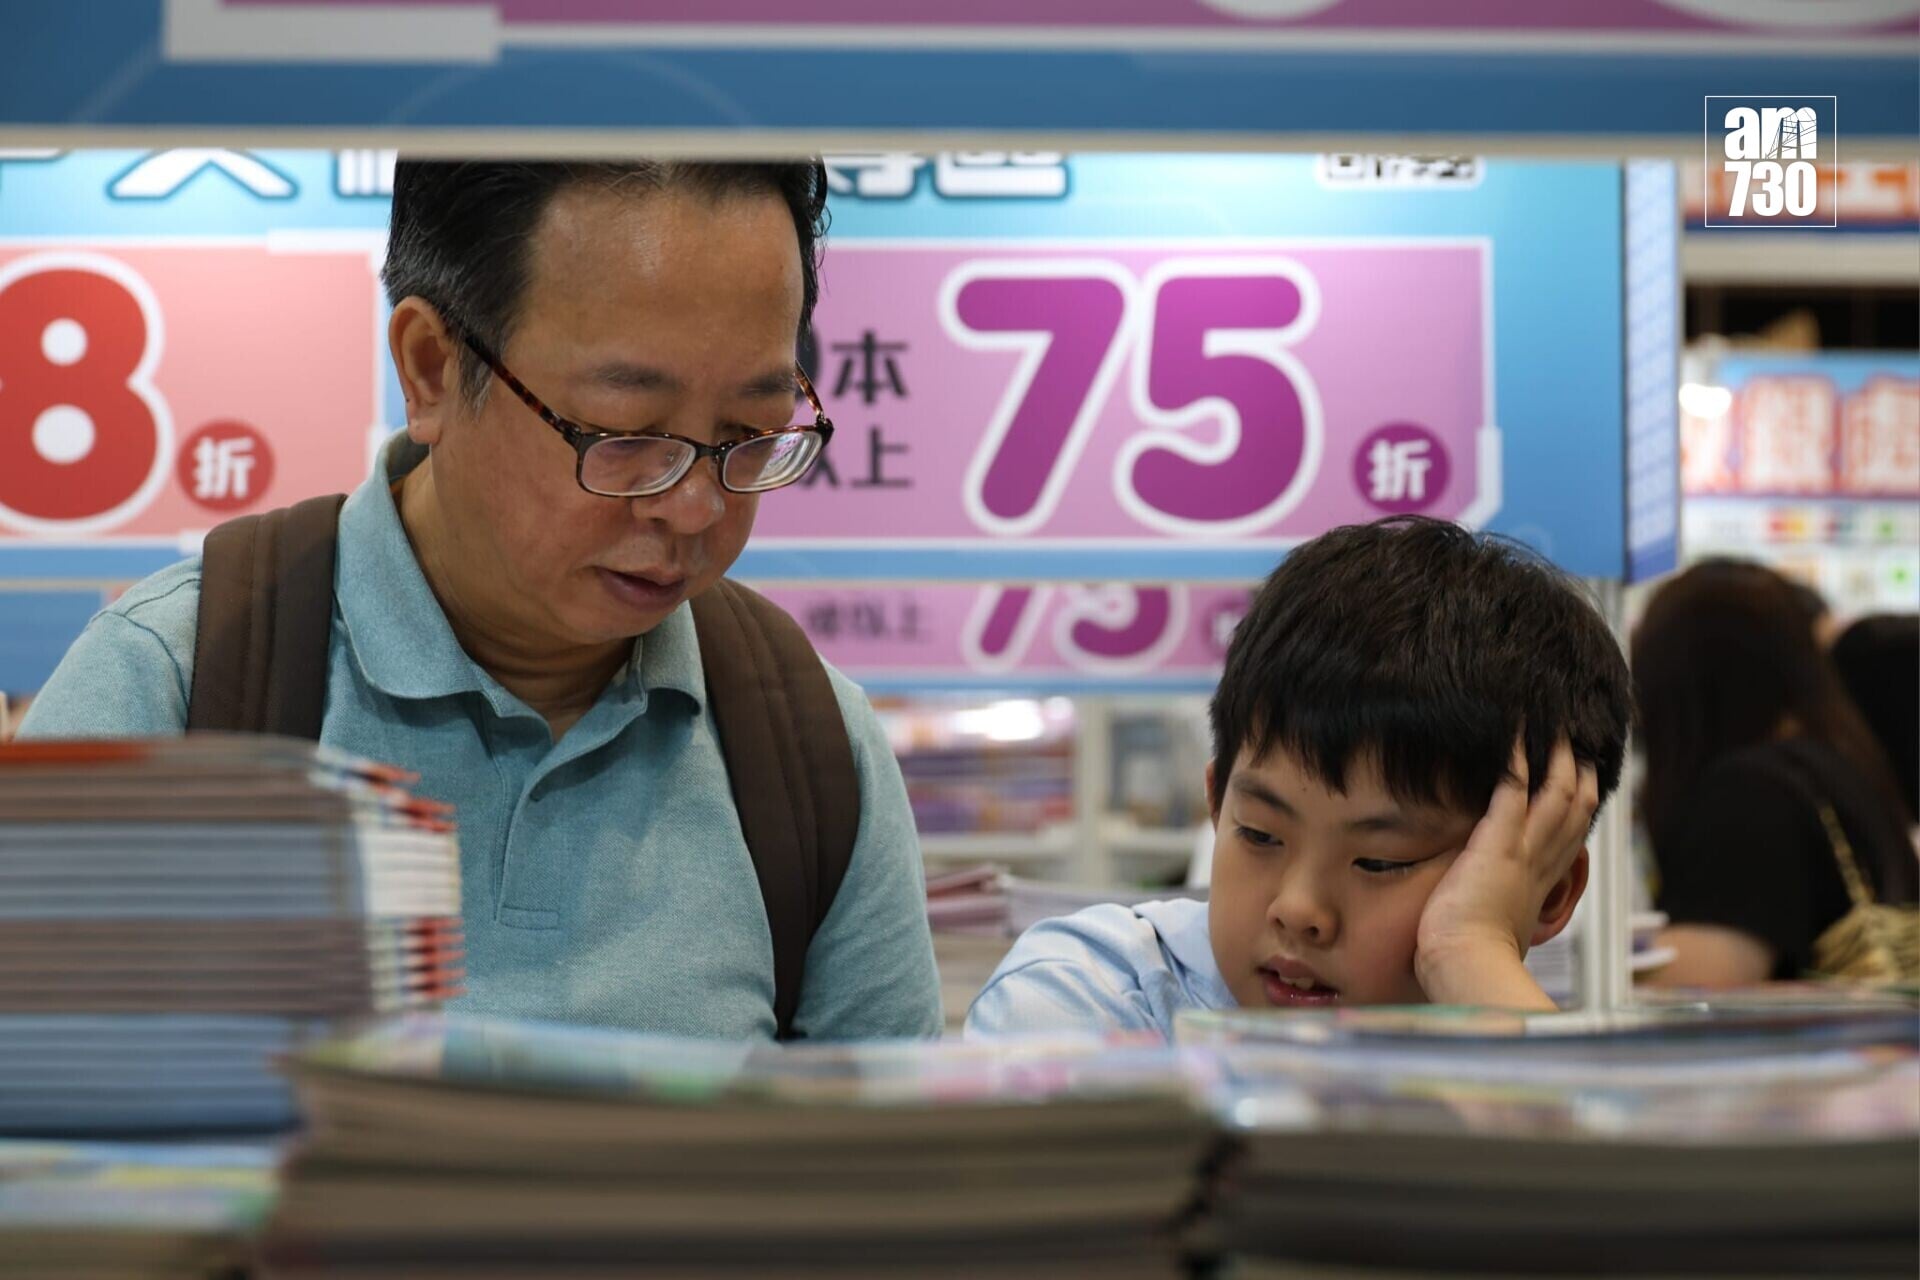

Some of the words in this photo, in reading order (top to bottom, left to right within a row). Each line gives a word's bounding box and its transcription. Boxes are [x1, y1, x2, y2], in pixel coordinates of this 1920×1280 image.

[0, 256, 170, 530] 8
[193, 437, 254, 500] 折
[944, 264, 1316, 530] 75
[1368, 438, 1431, 501] 折
